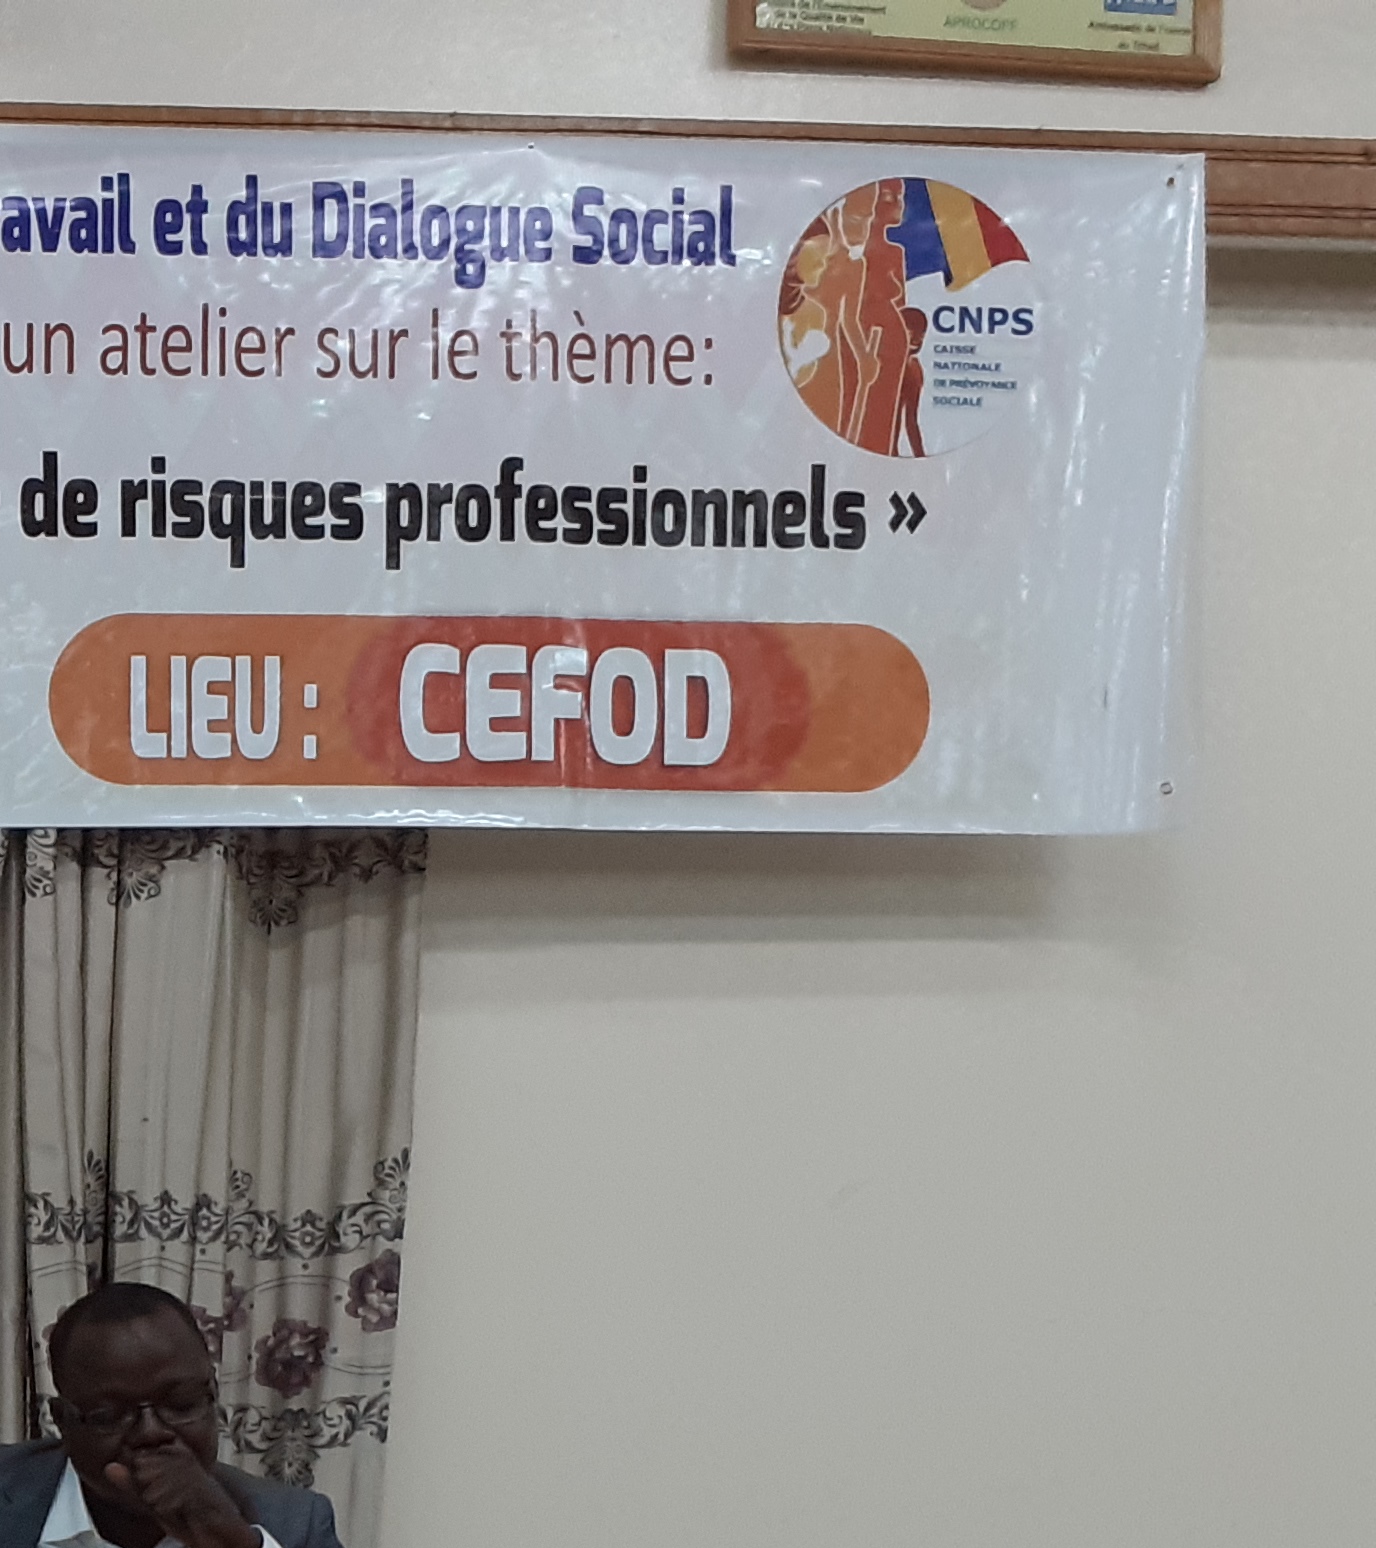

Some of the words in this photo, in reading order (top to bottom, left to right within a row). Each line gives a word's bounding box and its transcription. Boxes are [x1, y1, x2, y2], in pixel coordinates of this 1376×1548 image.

[154, 184, 208, 256] et
[226, 174, 292, 257] du
[312, 179, 552, 289] Dialogue
[572, 185, 736, 267] Social
[4, 323, 74, 374] un
[100, 303, 295, 377] atelier
[317, 327, 408, 379] sur
[432, 308, 478, 380] le
[500, 310, 716, 386] thème:
[932, 304, 1034, 336] CNPS
[933, 344, 976, 354] CAISSE
[933, 361, 1002, 372] NATIONALE
[933, 396, 983, 407] SOCIALE
[21, 451, 98, 537] de
[121, 456, 363, 568] risques
[386, 457, 866, 570] professionnels
[131, 656, 280, 759] LIEU
[400, 643, 731, 765] CEFOD
